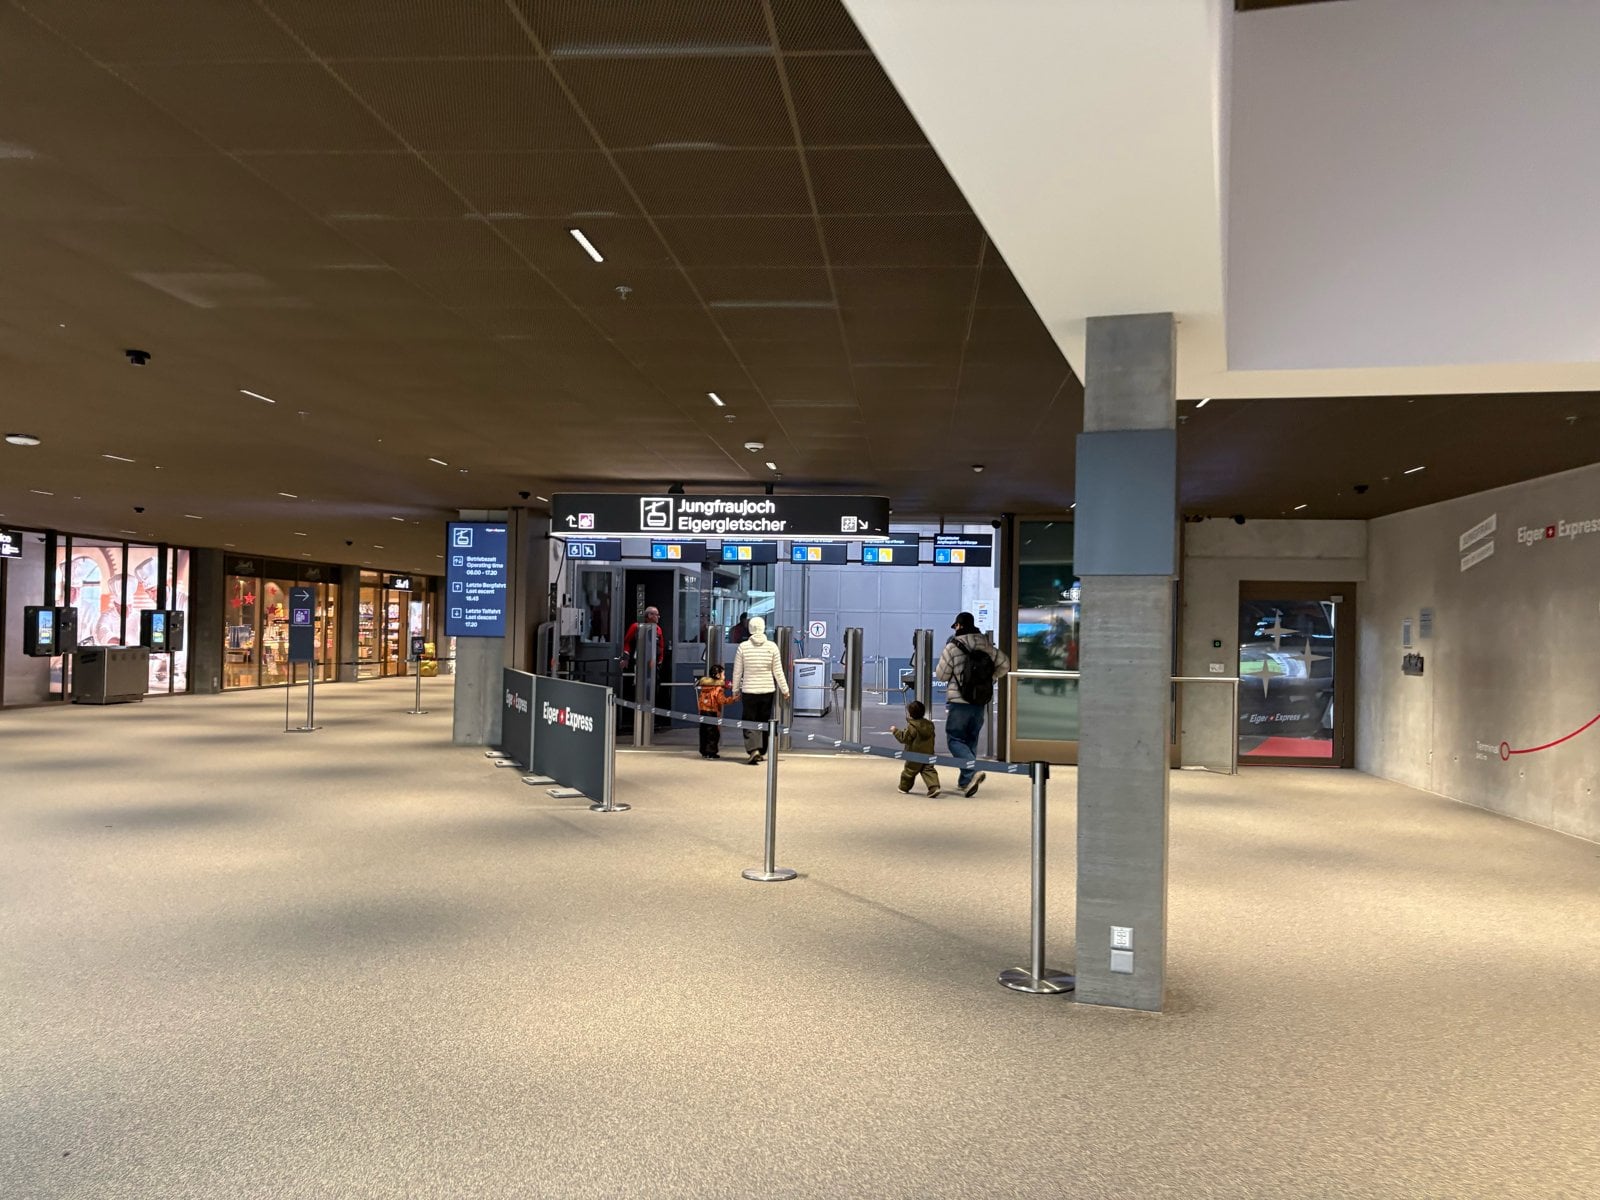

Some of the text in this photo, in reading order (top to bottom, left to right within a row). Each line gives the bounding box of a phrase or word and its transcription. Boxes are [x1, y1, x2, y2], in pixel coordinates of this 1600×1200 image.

[677, 499, 776, 516] Jungfraujoch
[679, 517, 786, 533] Eigergletscher
[1517, 526, 1545, 546] Eiger
[506, 688, 514, 709] Eiger
[542, 700, 594, 732] Eiger Express
[1249, 712, 1301, 724] Eiger Express
